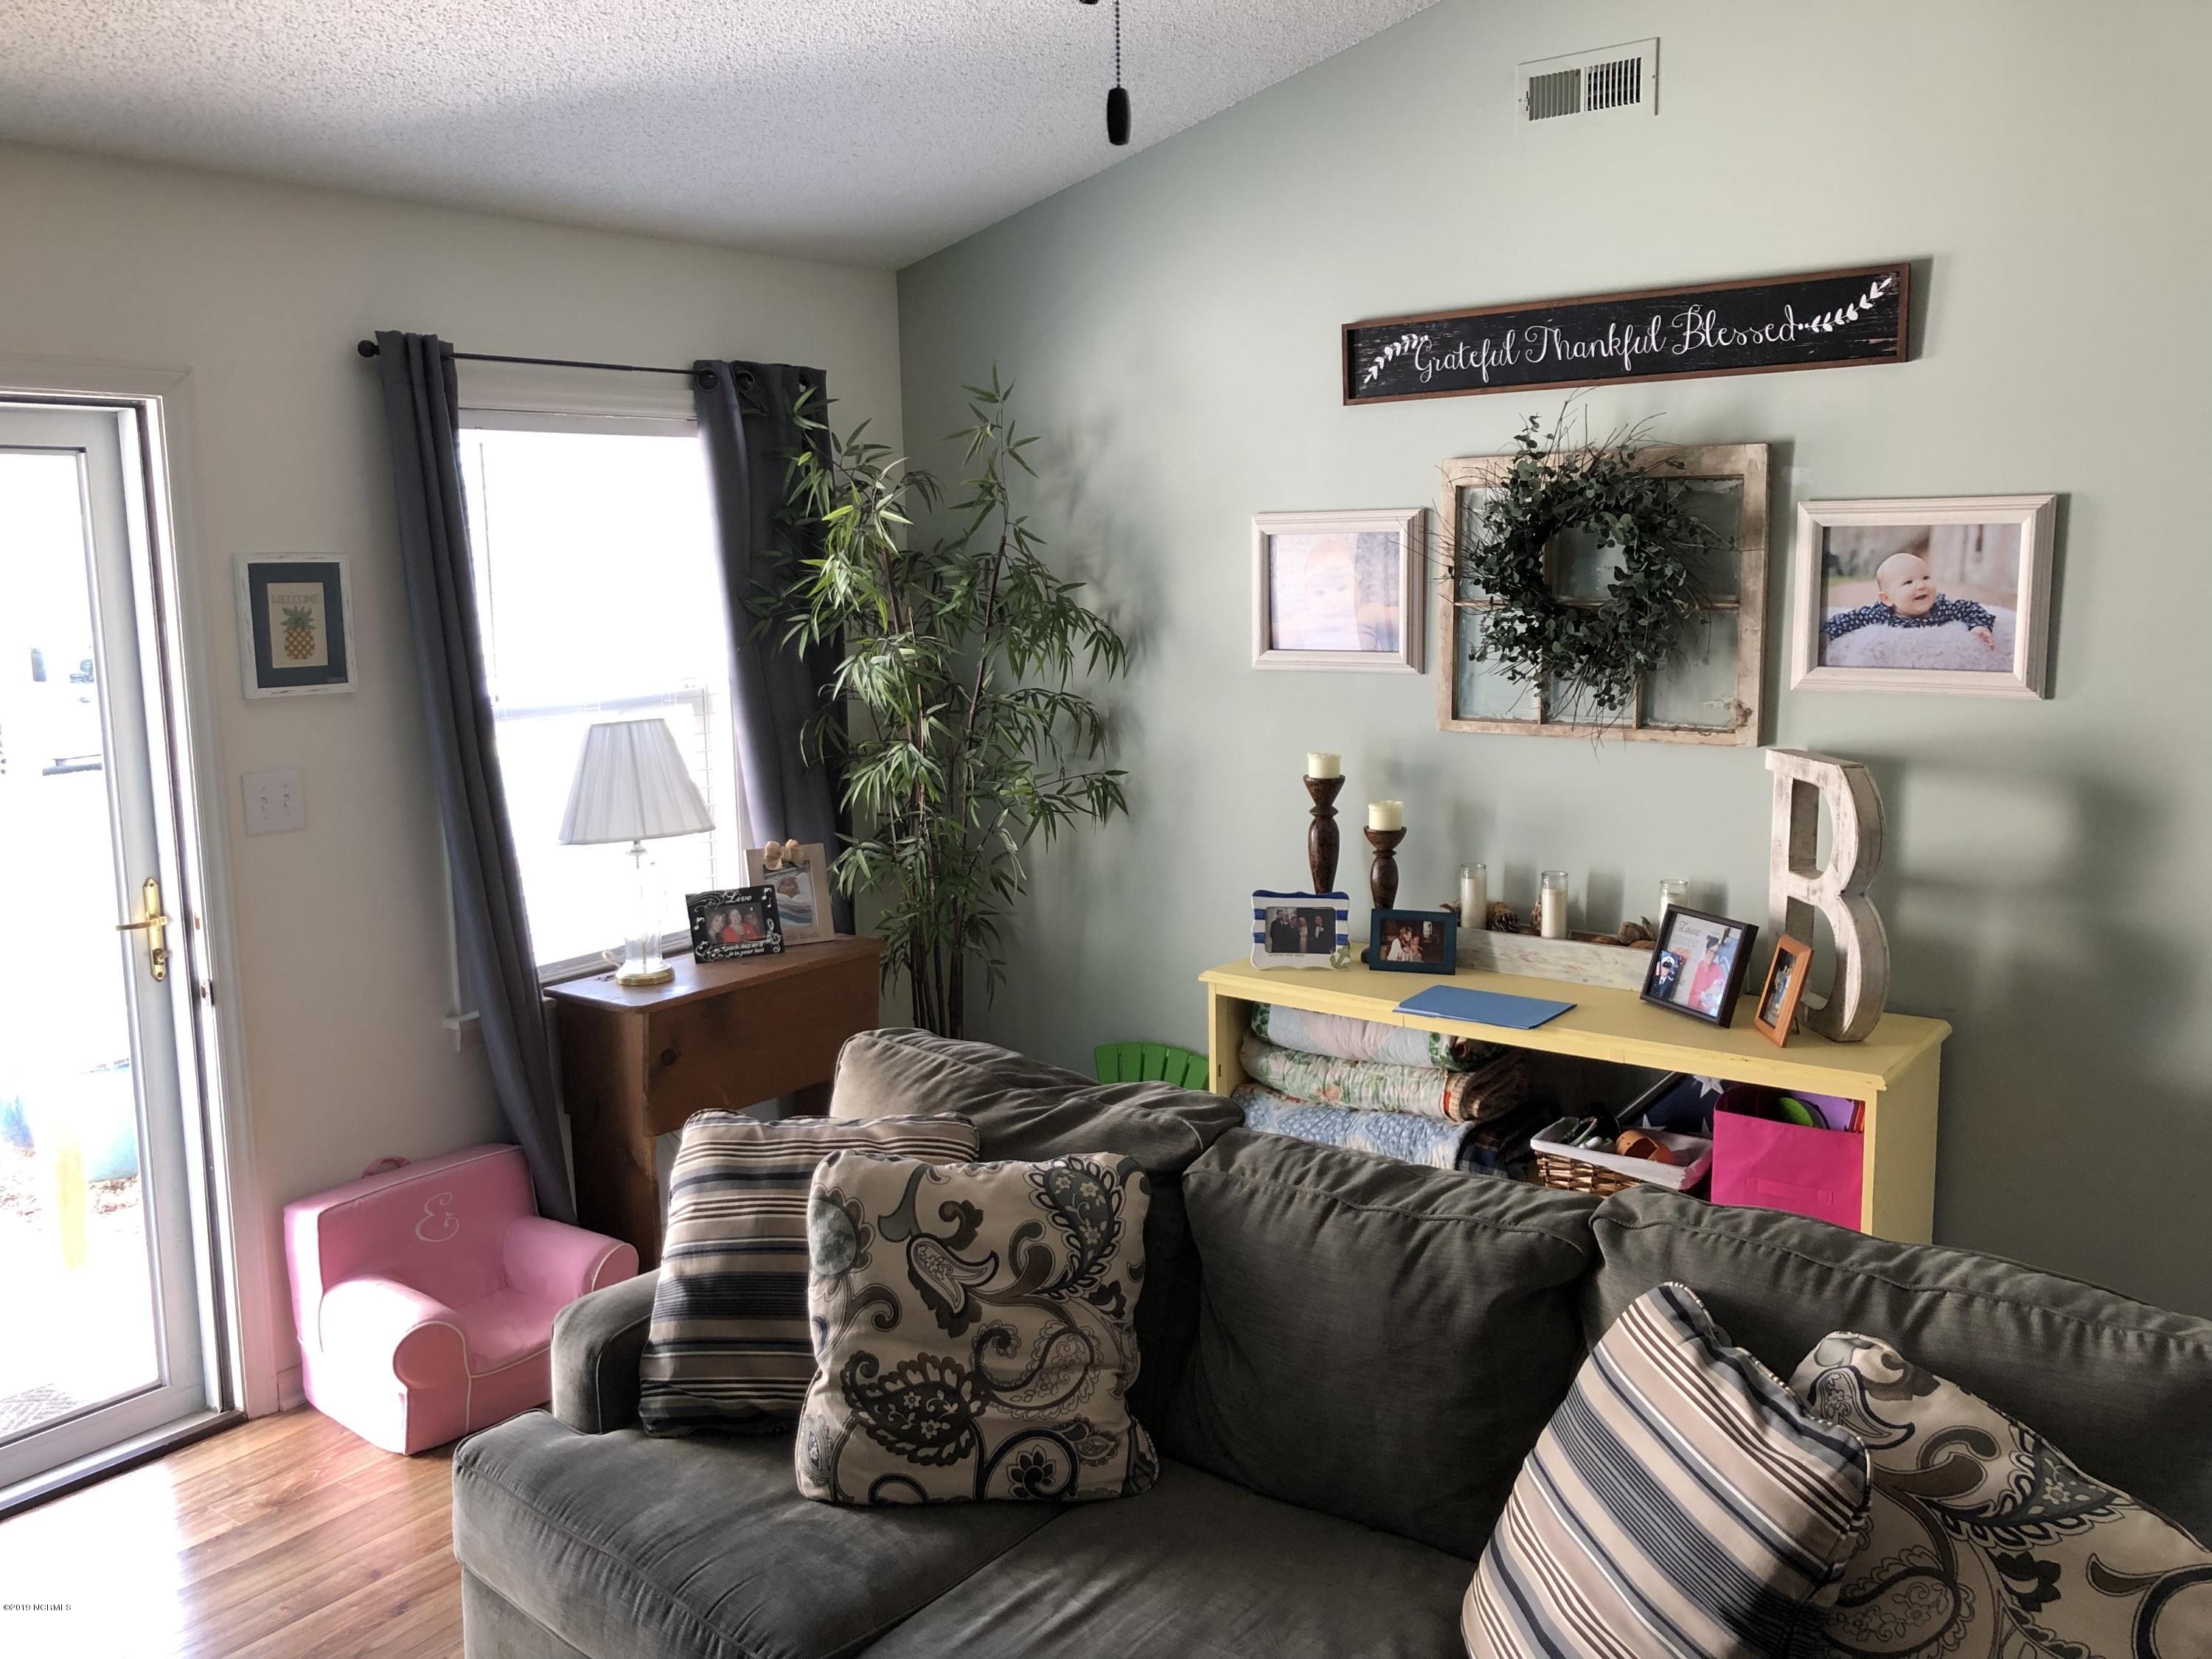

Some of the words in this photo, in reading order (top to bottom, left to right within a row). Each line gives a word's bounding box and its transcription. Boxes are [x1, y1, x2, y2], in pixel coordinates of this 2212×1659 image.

[1414, 330, 1520, 383] Grateful
[1525, 315, 1666, 372] Thankful
[1672, 304, 1797, 355] Blessed
[271, 594, 320, 605] WELCOME
[725, 890, 753, 904] Live
[1765, 748, 1891, 1042] B
[1677, 920, 1701, 936] Love
[738, 949, 754, 958] your
